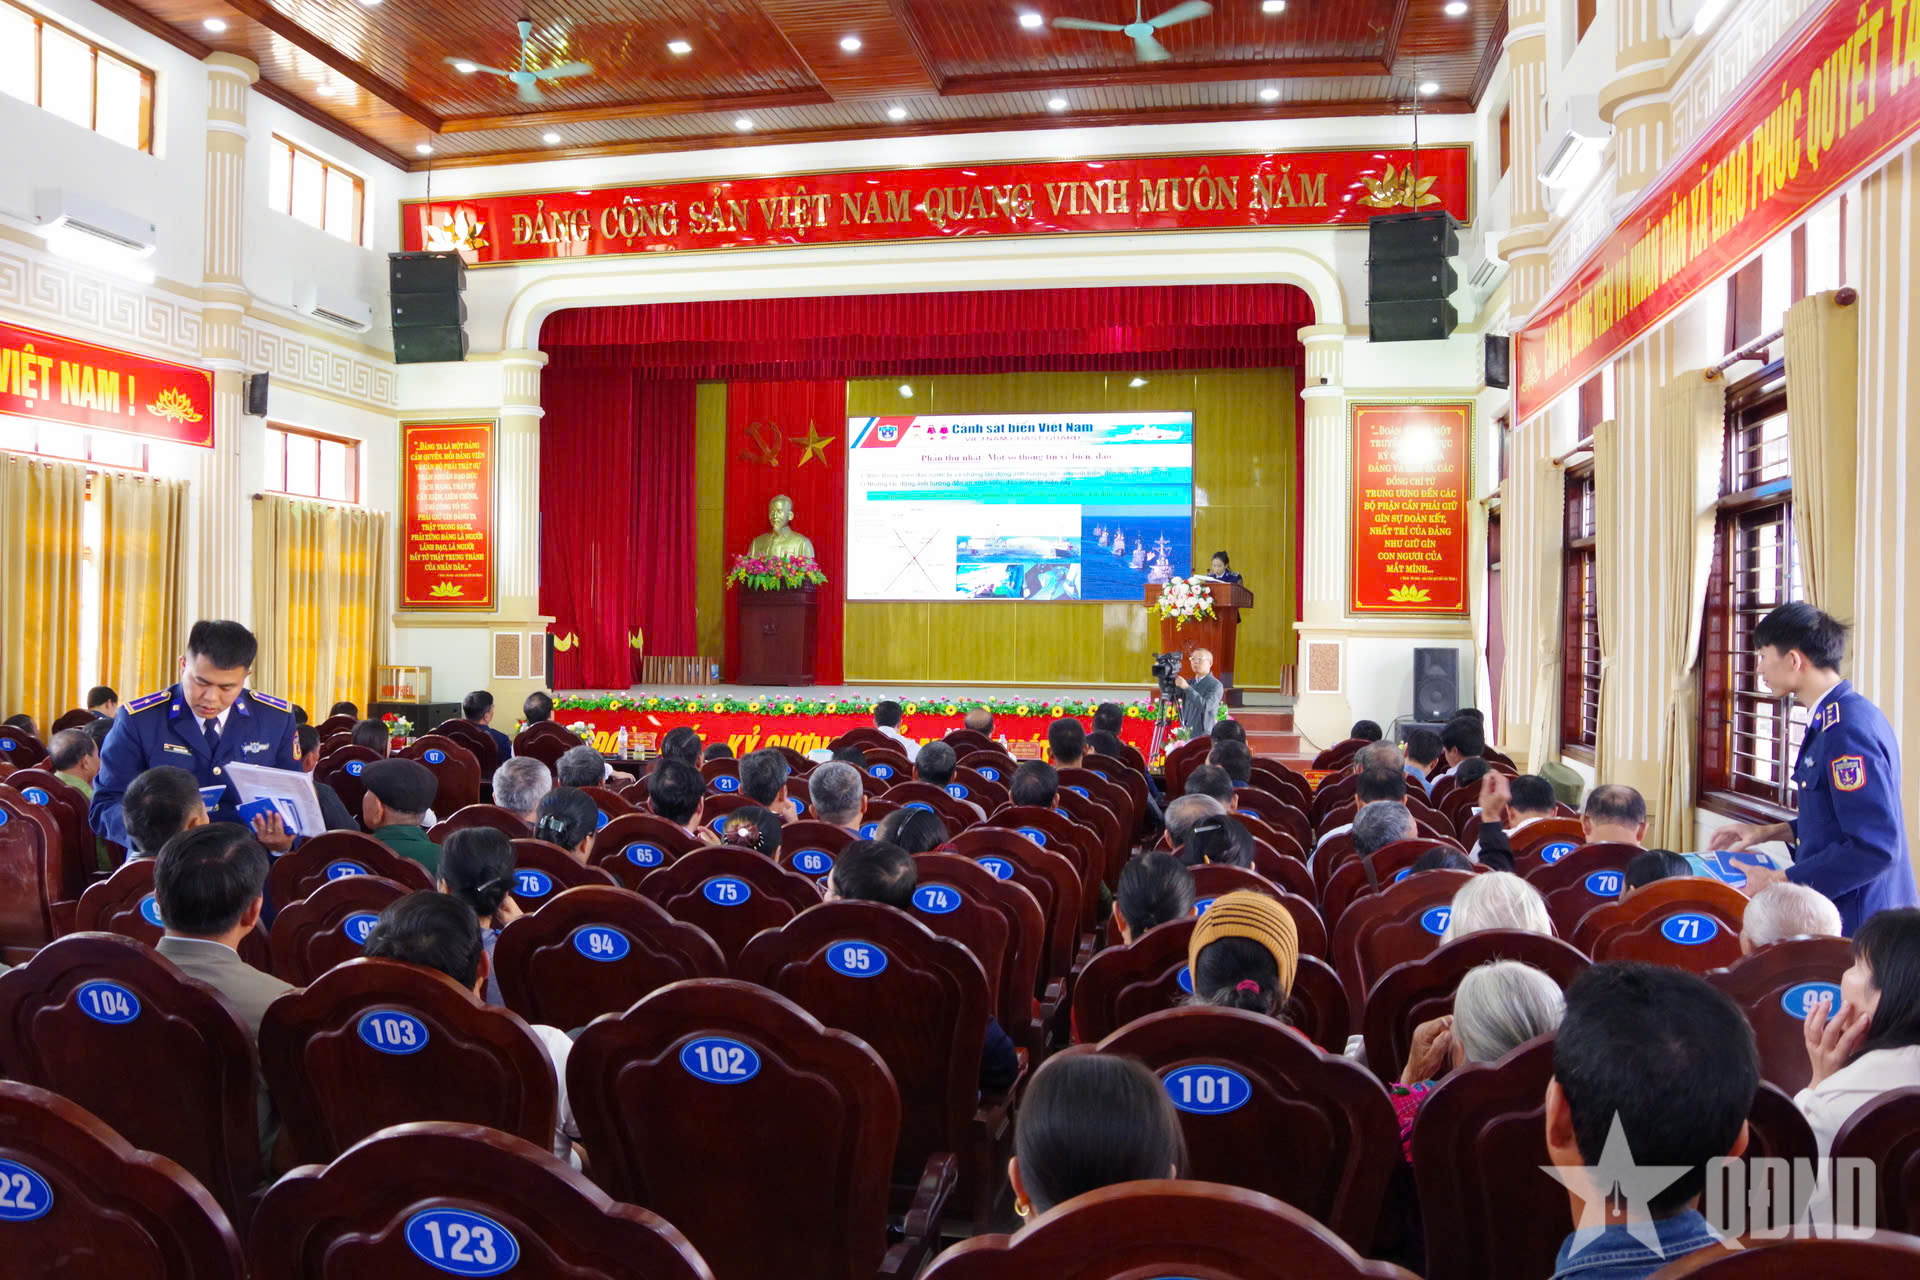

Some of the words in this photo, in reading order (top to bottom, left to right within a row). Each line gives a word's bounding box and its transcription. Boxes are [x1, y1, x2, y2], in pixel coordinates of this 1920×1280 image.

[1661, 191, 1687, 285] DÂN
[1712, 138, 1748, 244] GIAO
[1751, 79, 1802, 212] PHÚC
[512, 199, 590, 244] ĐẢNG
[600, 195, 679, 246] CỘNG
[690, 187, 749, 233] SẢN
[757, 185, 832, 236] VIỆT
[840, 189, 912, 225] NAM
[923, 183, 1034, 228] QUANG
[1043, 180, 1130, 216] VINH
[1140, 165, 1239, 213] MUÔN
[1249, 163, 1328, 209] NĂM
[0, 343, 53, 408] VIỆT
[60, 360, 120, 414] NAM
[1066, 422, 1093, 433] Nam
[351, 764, 362, 774] 22
[875, 767, 887, 777] 09
[721, 778, 733, 789] 21
[637, 847, 653, 863] 65
[806, 855, 822, 869] 66
[519, 876, 540, 893] 76
[716, 883, 738, 902] 75
[1597, 876, 1619, 891] 70
[925, 890, 948, 909] 74
[1677, 919, 1700, 939] 71
[588, 933, 614, 954] 94
[843, 947, 870, 970] 95
[88, 989, 130, 1016] 104
[370, 1018, 416, 1046] 103
[694, 1046, 747, 1075] 102
[1174, 1075, 1231, 1105] 101
[424, 1220, 498, 1265] 123
